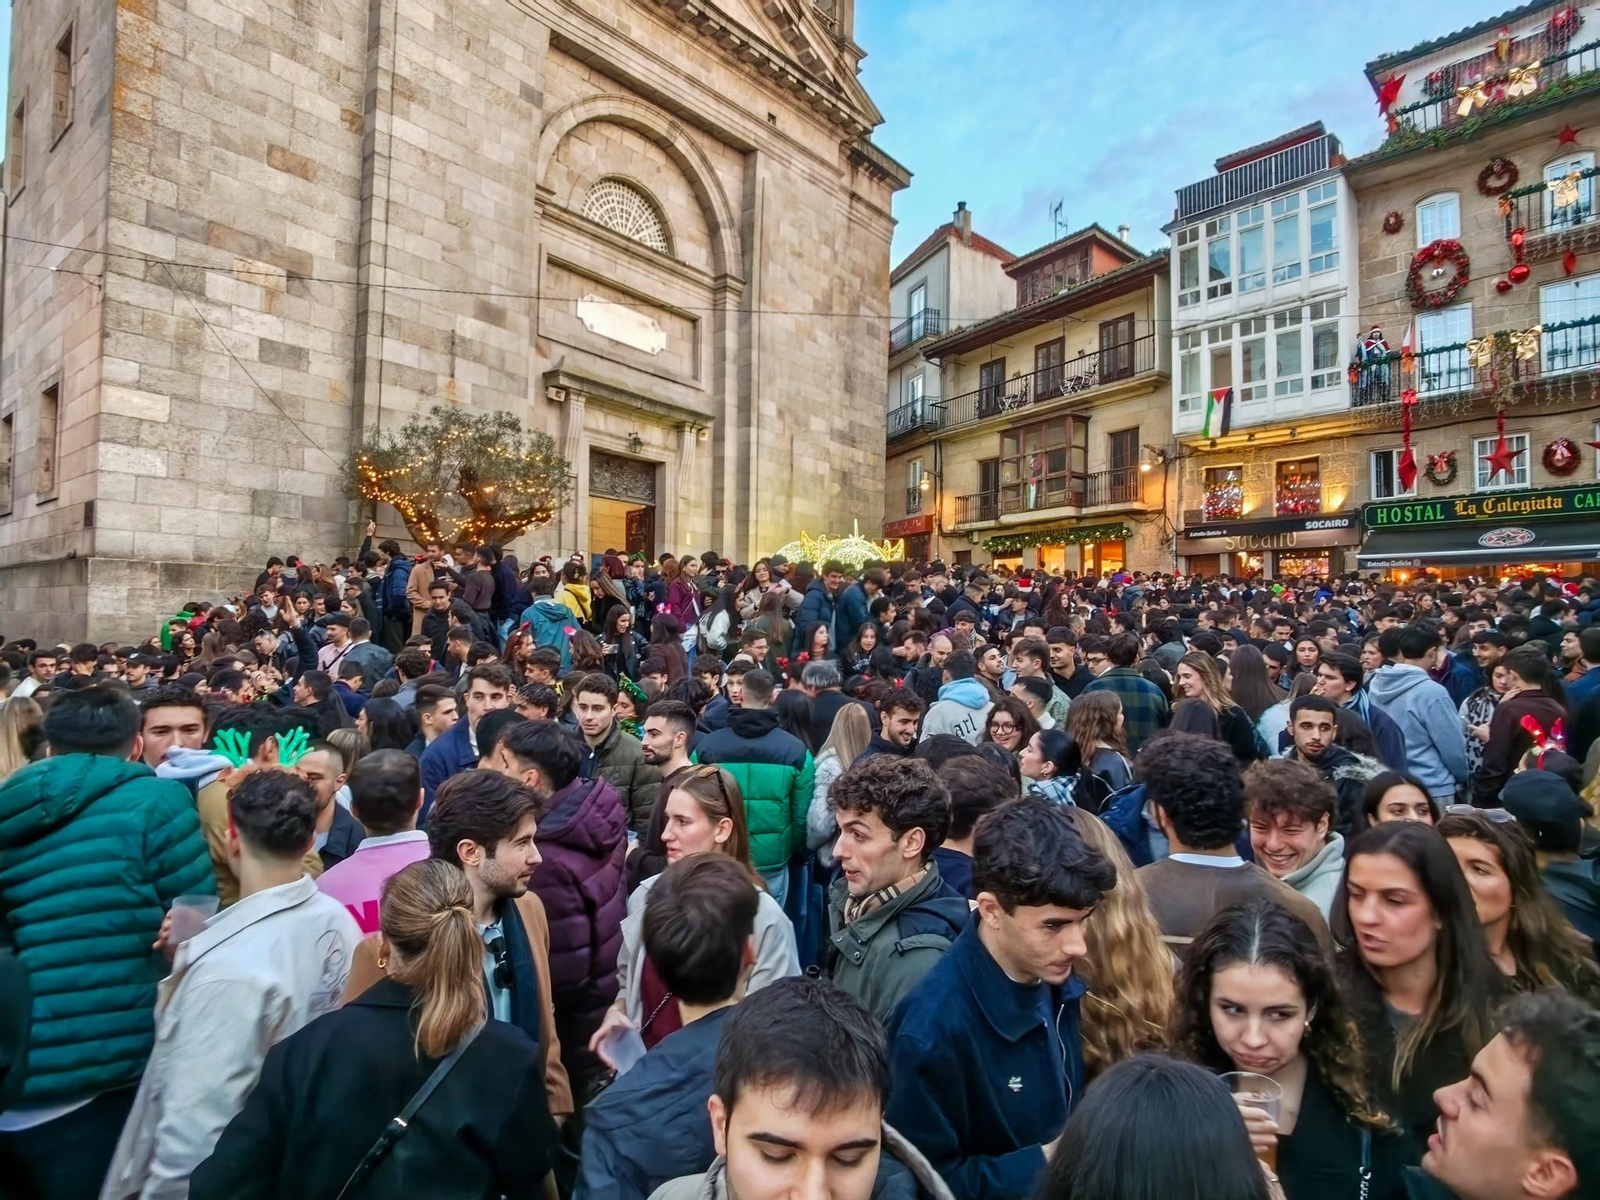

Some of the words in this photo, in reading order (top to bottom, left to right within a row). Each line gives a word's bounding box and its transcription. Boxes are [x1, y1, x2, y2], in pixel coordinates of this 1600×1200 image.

[1377, 504, 1445, 524] HOSTAL
[1454, 500, 1477, 516] La
[1483, 495, 1563, 514] Colegiata
[1305, 519, 1349, 530] SOCAIRO
